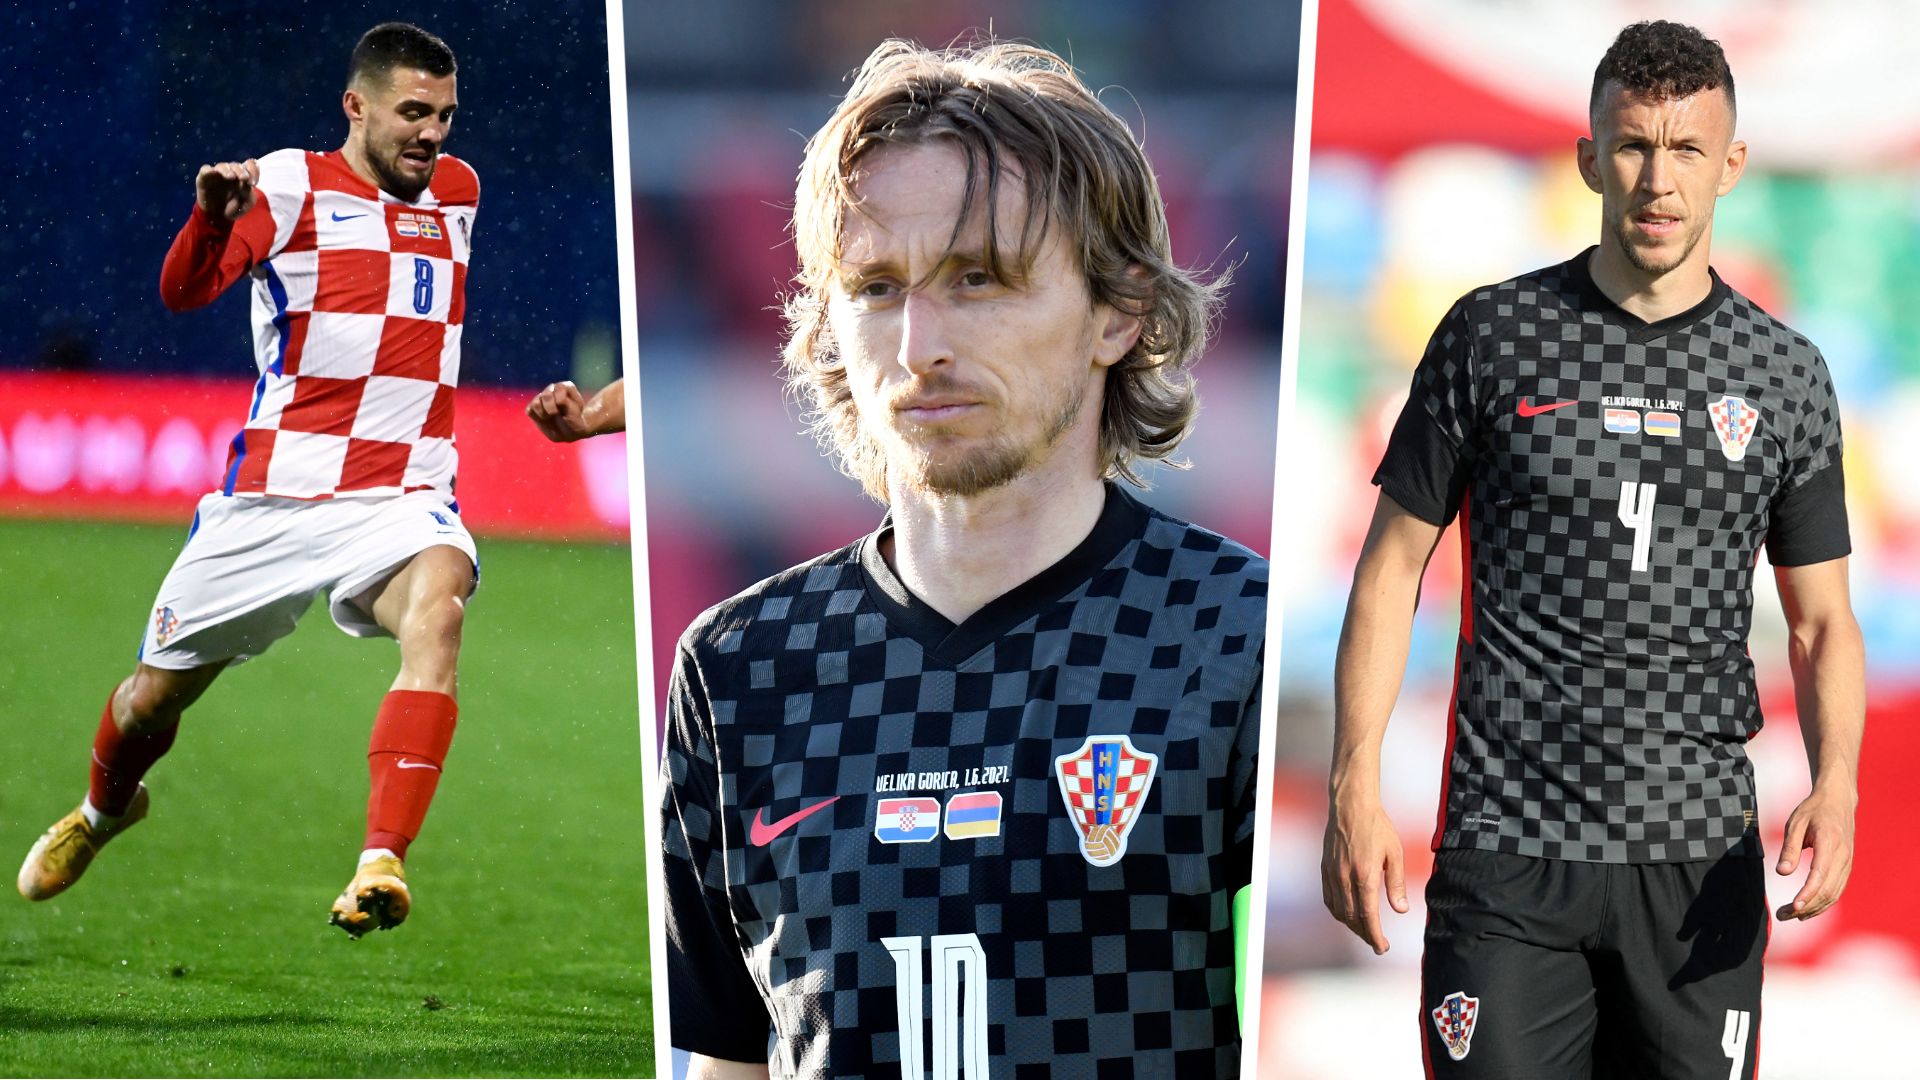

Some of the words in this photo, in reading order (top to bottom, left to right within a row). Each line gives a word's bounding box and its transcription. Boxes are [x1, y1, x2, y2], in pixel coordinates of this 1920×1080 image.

[413, 257, 434, 315] 8
[1617, 480, 1658, 572] 4
[875, 772, 916, 793] VELIKA
[917, 770, 960, 791] GORICA,
[964, 765, 1010, 787] 1.6.2021.
[879, 932, 990, 1080] 10
[1721, 1008, 1751, 1080] 4
